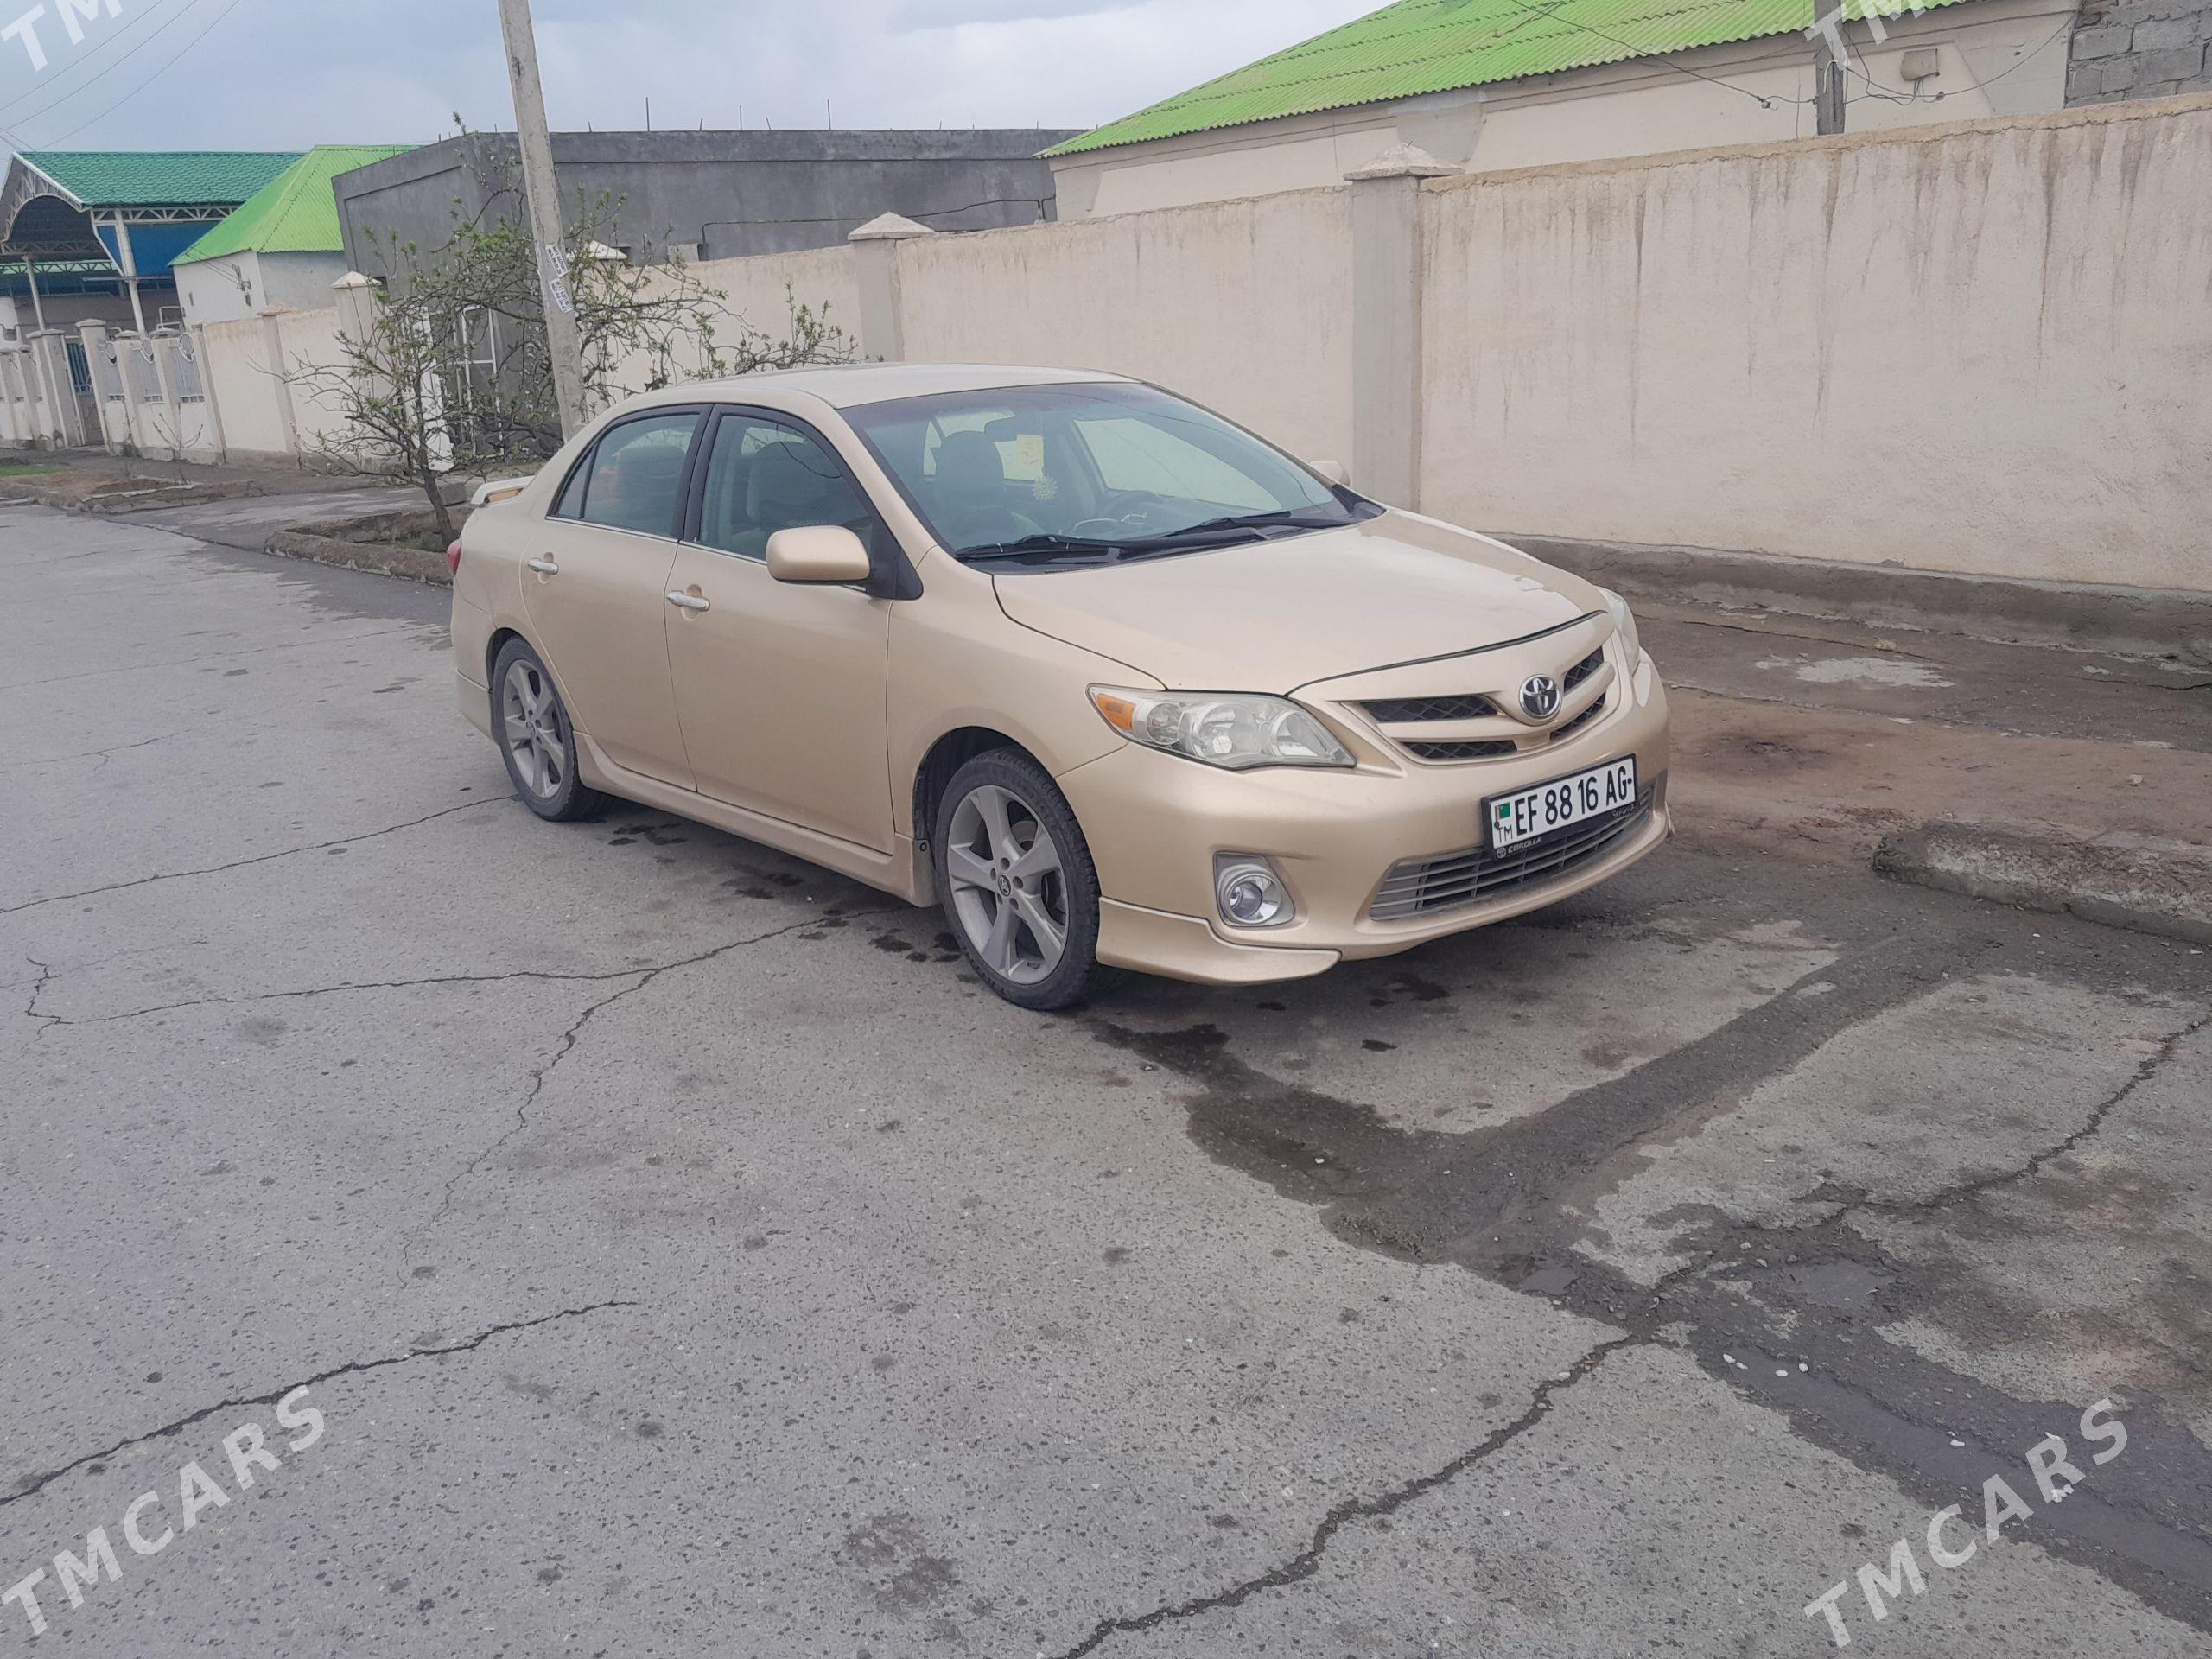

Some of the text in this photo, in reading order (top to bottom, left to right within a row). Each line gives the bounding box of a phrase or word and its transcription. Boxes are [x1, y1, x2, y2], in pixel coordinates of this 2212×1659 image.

[1515, 766, 1628, 836] EF 8816 AG
